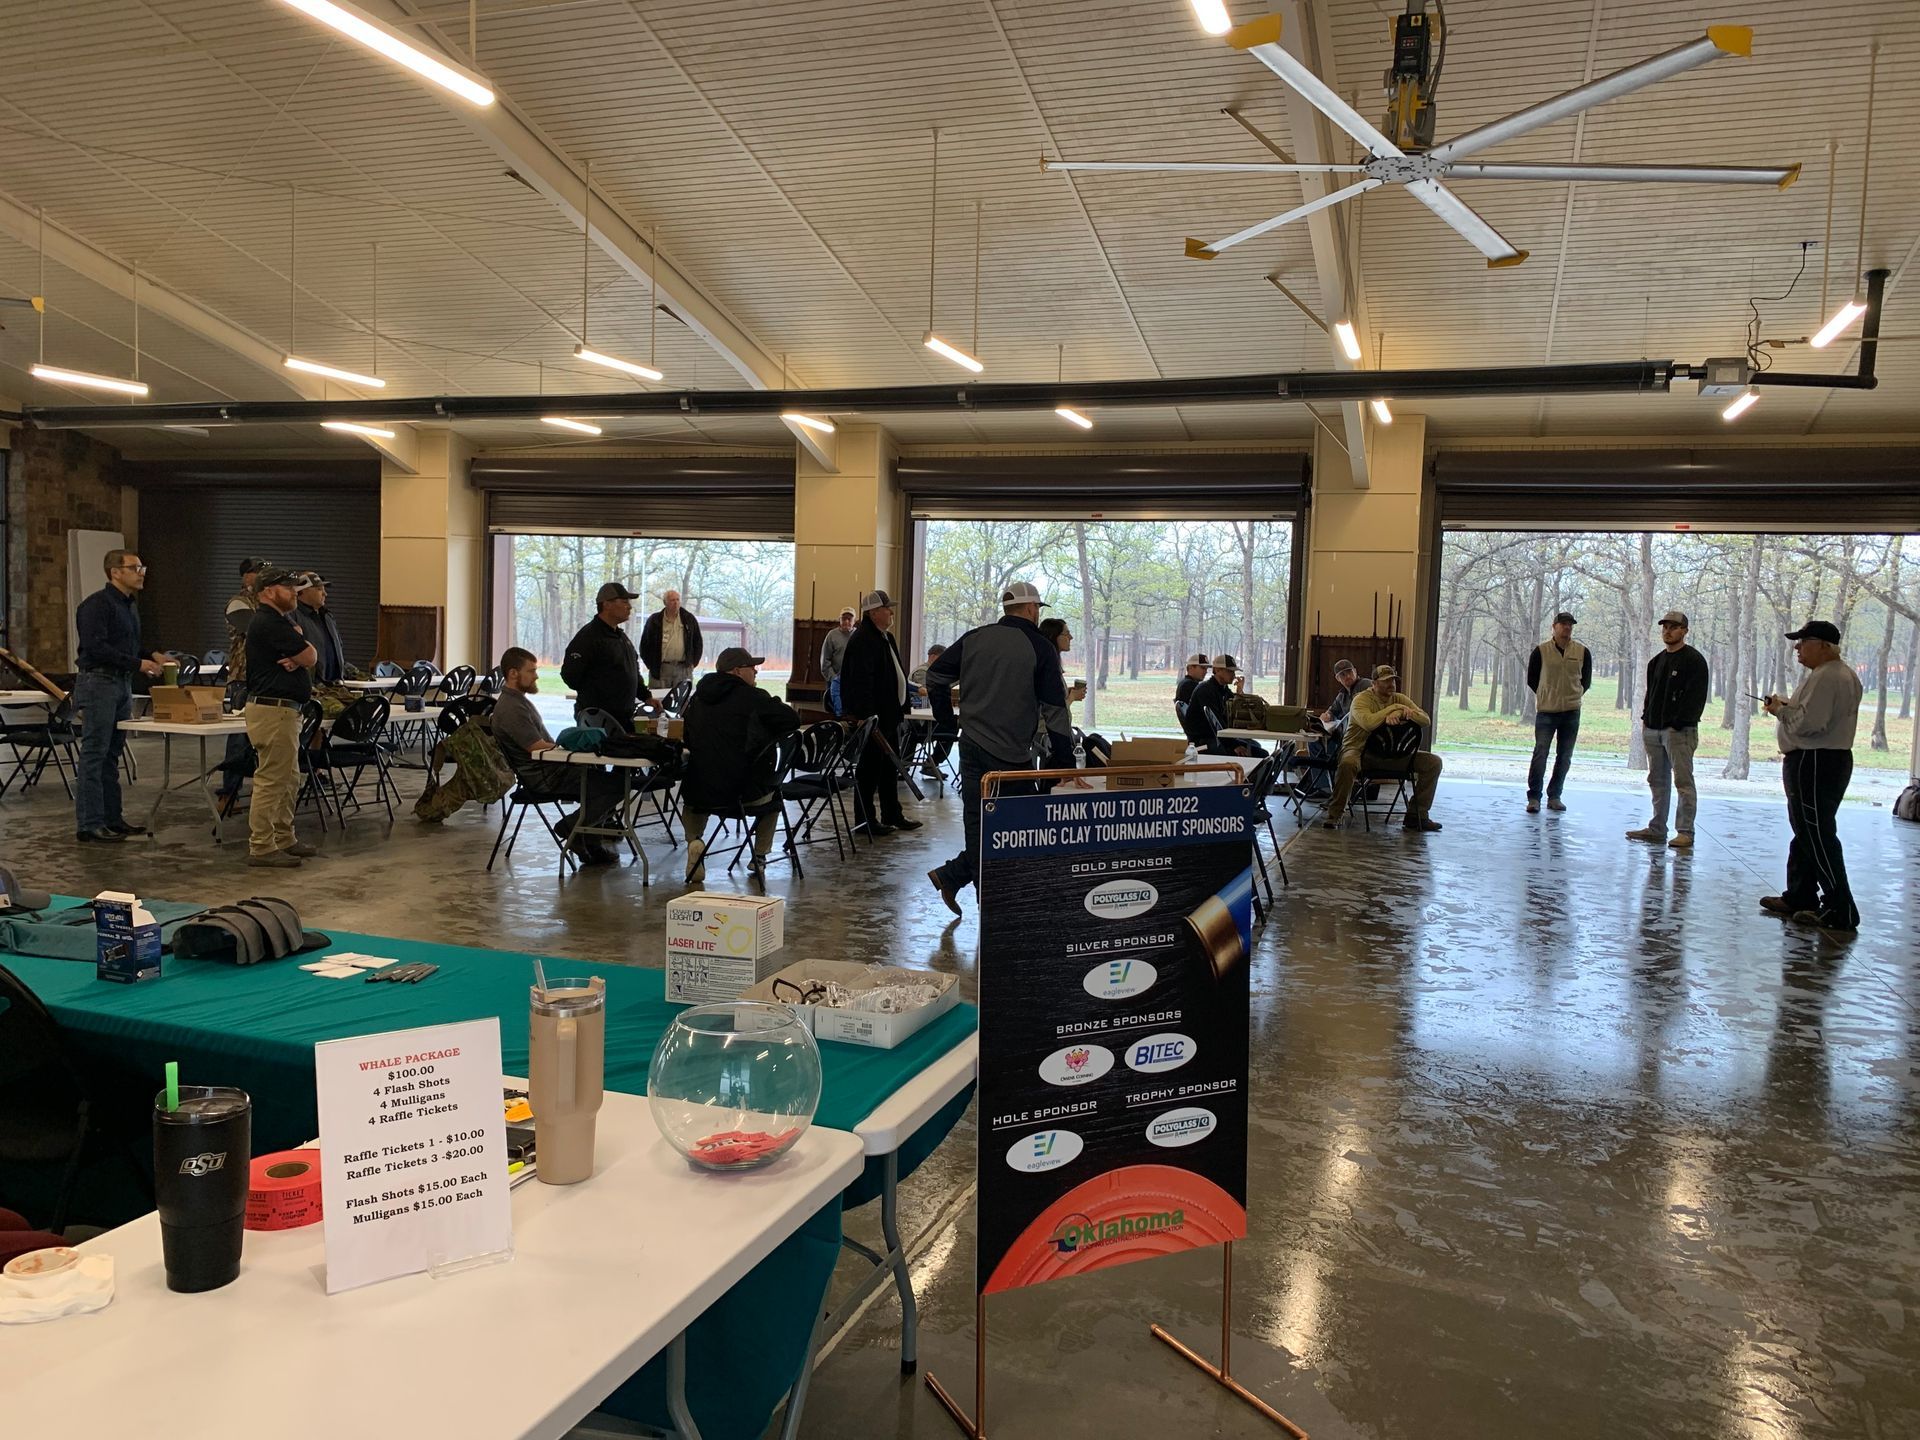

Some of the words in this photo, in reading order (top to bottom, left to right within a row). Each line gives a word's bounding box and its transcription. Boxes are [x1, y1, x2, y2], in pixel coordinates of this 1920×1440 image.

[1045, 802, 1088, 822] THANK
[1092, 801, 1116, 819] YOU
[1120, 800, 1136, 817] TO
[1139, 798, 1163, 816] OUR
[1167, 796, 1198, 814] 2022
[992, 829, 1057, 850] SPORTING
[1061, 826, 1091, 844] CLAY
[1095, 820, 1178, 842] TOURNAMENT
[1182, 816, 1244, 836] SPONSORS
[1071, 862, 1106, 873] GOLD
[1111, 857, 1172, 869] SPONSOR
[1093, 892, 1138, 904] POLYGLASS
[668, 937, 694, 948] LASER
[1066, 940, 1109, 953] SILVER
[1114, 934, 1175, 947] SPONSOR
[1103, 987, 1136, 997] eagleview
[1056, 1019, 1108, 1034] BRONZE
[1113, 1010, 1182, 1026] SPONSORS
[359, 1056, 402, 1072] WHALE
[405, 1048, 460, 1064] PACKAGE
[1135, 1041, 1184, 1066] BITEC
[388, 1065, 434, 1081] $100.00
[373, 1088, 380, 1097] 4
[384, 1081, 415, 1096] Flash
[418, 1075, 450, 1089] Shots
[1126, 1089, 1175, 1104] TROPHY
[1179, 1079, 1237, 1096] SPONSOR
[380, 1101, 387, 1109] 4
[391, 1091, 445, 1108] Mulligans
[368, 1117, 375, 1126] 4
[379, 1110, 413, 1124] Raffle
[416, 1102, 458, 1117] Tickets
[992, 1112, 1029, 1126] HOLE
[1034, 1100, 1098, 1118] SPONSOR
[1155, 1119, 1197, 1134] POLYGLASS
[344, 1150, 378, 1164] Raffle
[381, 1141, 425, 1156] Tickets
[429, 1139, 434, 1147] 1
[446, 1129, 484, 1144] $10.00
[181, 1153, 225, 1175] OSU
[346, 1166, 381, 1180] Raffle
[384, 1157, 427, 1172] Tickets
[431, 1154, 438, 1163] 3
[1027, 1159, 1061, 1170] eagleview
[346, 1196, 378, 1210] Flash
[381, 1187, 415, 1201] Shots
[418, 1178, 457, 1194] $15.00
[460, 1171, 488, 1184] Each
[353, 1205, 410, 1224] Mulligans
[413, 1196, 452, 1212] $15.00
[455, 1188, 483, 1201] Each
[1064, 1208, 1184, 1247] Oklahoma
